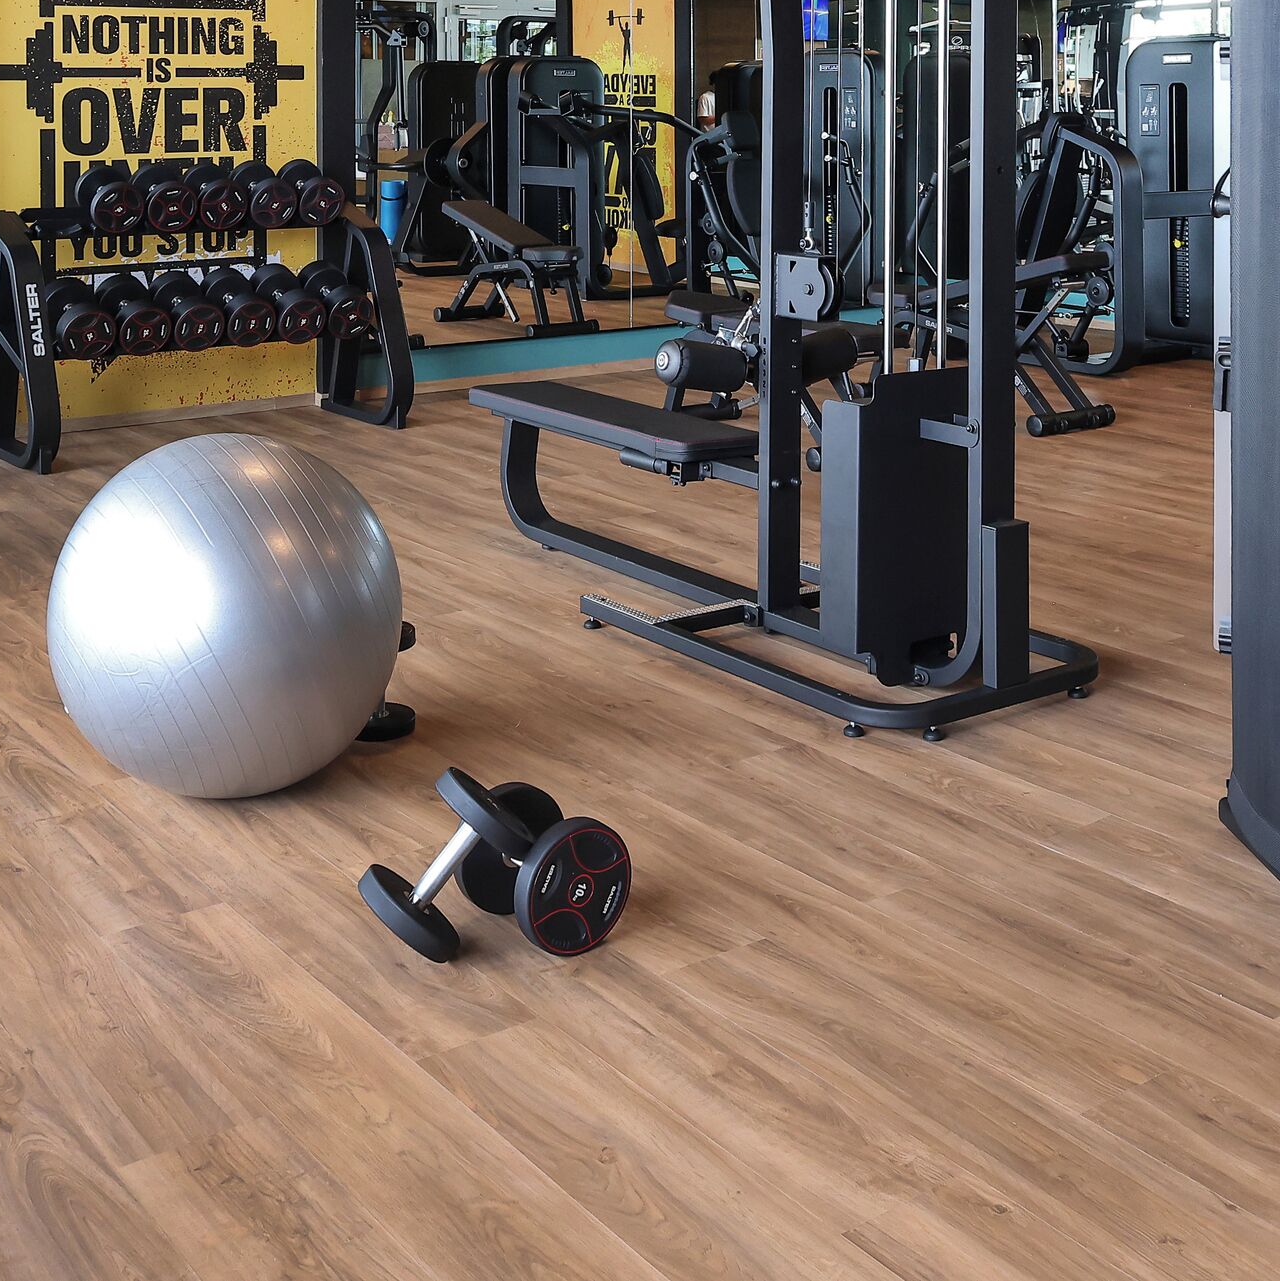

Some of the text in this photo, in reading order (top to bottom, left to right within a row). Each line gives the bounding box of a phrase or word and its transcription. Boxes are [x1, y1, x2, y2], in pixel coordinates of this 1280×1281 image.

[62, 14, 245, 55] NOTHING
[146, 57, 171, 83] IS
[62, 87, 248, 157] OVER
[33, 283, 46, 357] SALTER
[602, 885, 617, 914] SALTER
